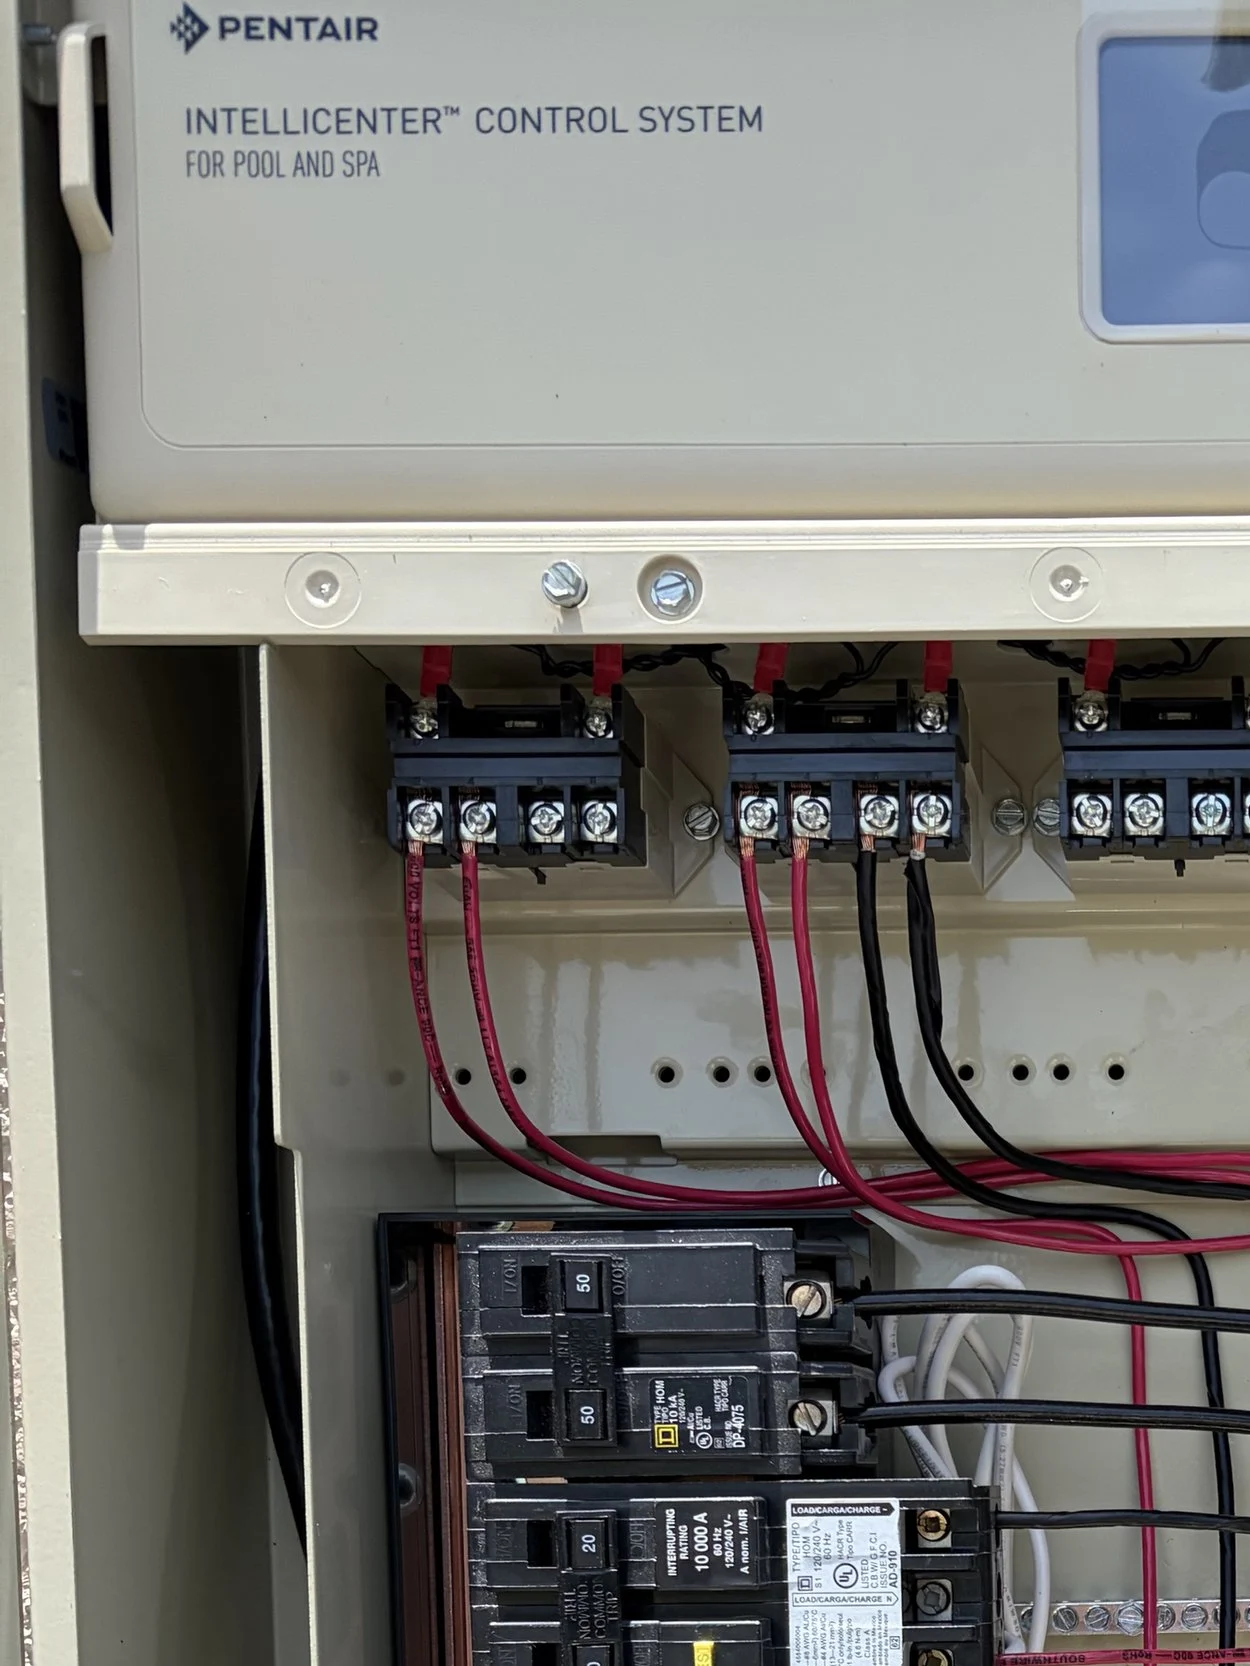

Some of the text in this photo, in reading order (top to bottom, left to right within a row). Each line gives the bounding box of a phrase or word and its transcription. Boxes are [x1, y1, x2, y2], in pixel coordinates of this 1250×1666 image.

[218, 16, 378, 42] PENTAIR
[475, 105, 628, 136] CONTROL
[638, 104, 764, 134] SYSTEM
[185, 150, 381, 179] FOR POOL AND SPA
[576, 1274, 591, 1293] 50
[655, 1380, 665, 1403] HOM
[580, 1406, 595, 1424] 50
[668, 1395, 678, 1423] 10 kA
[731, 1405, 746, 1447] DP-4075
[793, 1506, 881, 1514] LOAD/CARGA/CHARGE
[582, 1534, 596, 1553] 20
[665, 1509, 677, 1576] INTERRUPTING
[678, 1525, 689, 1559] RATING
[693, 1512, 709, 1572] 10 000 A
[713, 1527, 723, 1556] 60 Hz
[724, 1529, 734, 1568] 120/240
[739, 1537, 750, 1574] A nom.
[792, 1522, 800, 1572] TYPE/TIPO
[802, 1536, 810, 1558] HOM
[813, 1536, 822, 1571] 120/240
[823, 1533, 832, 1560] 60 Hz
[861, 1559, 869, 1589] LISTED
[888, 1550, 898, 1588] AD-910
